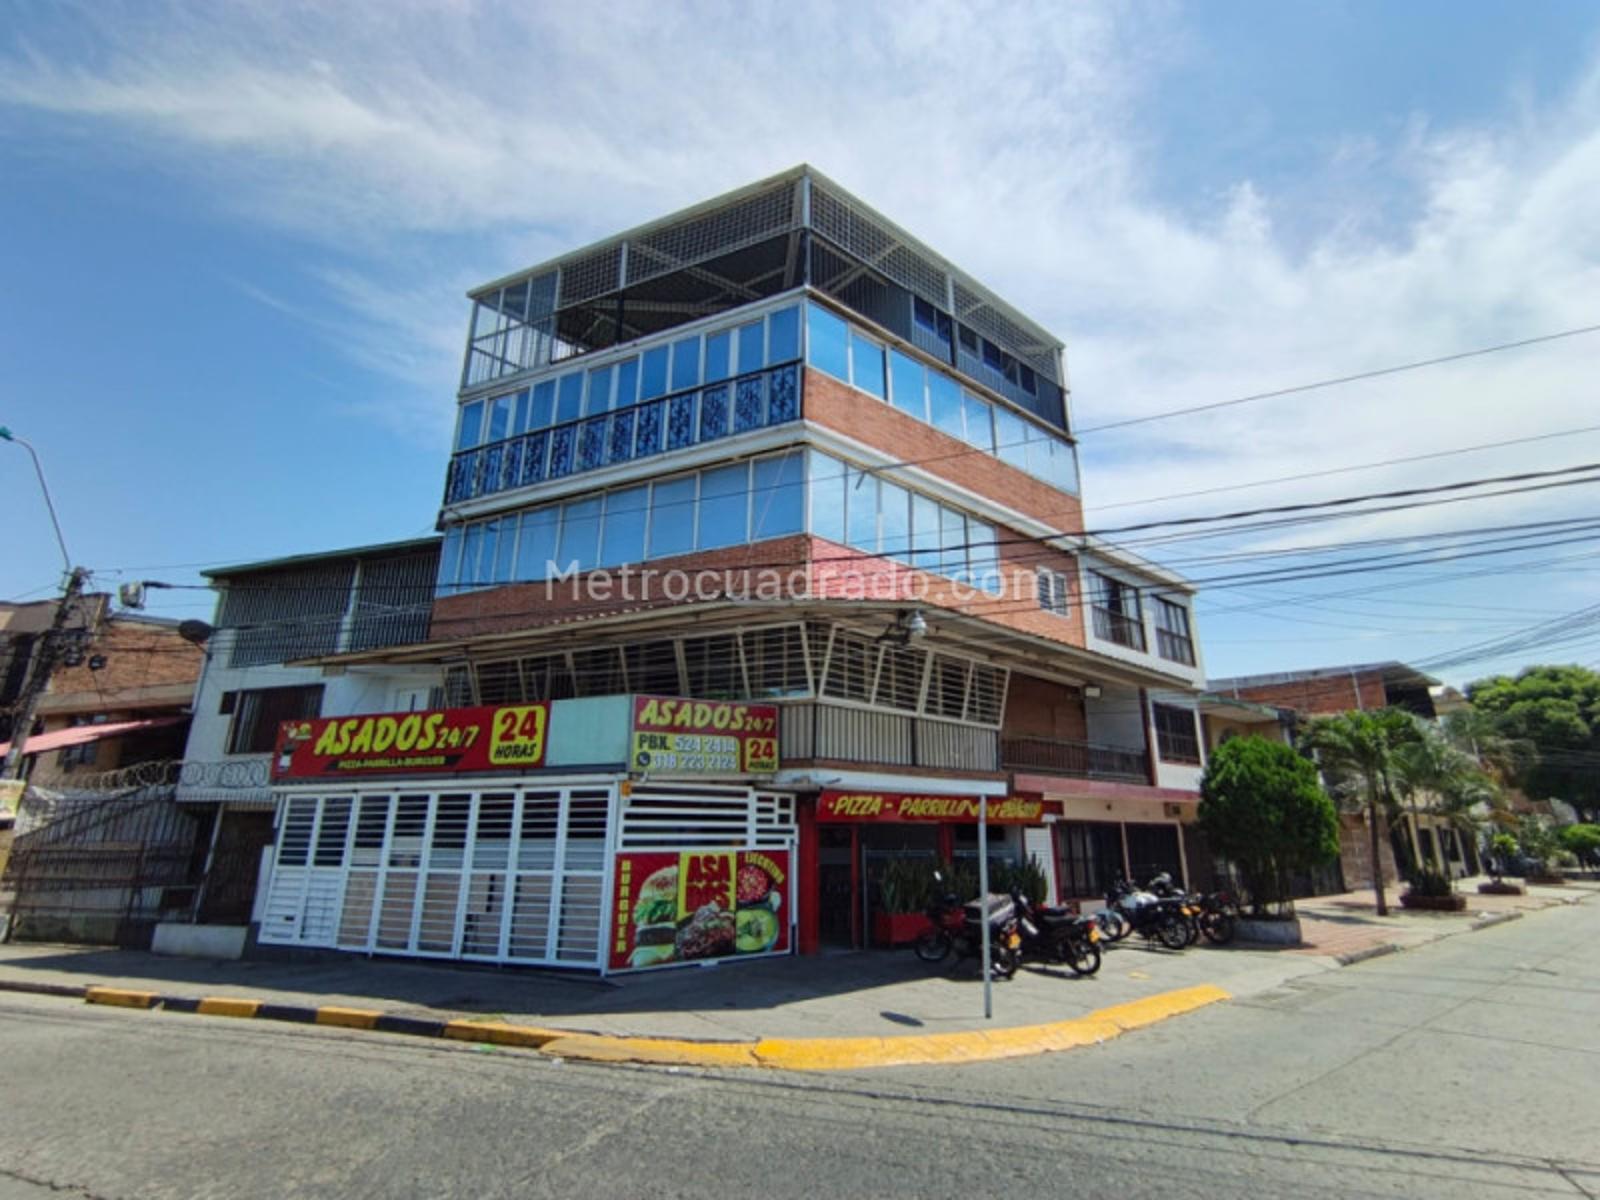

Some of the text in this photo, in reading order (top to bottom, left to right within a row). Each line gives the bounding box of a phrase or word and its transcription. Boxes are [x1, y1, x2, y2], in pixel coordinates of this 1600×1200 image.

[499, 710, 539, 741] 24
[639, 699, 747, 730] ASADOS
[314, 713, 479, 755] ASADOS 24/7
[750, 740, 774, 759] 24
[493, 743, 536, 758] HORAS
